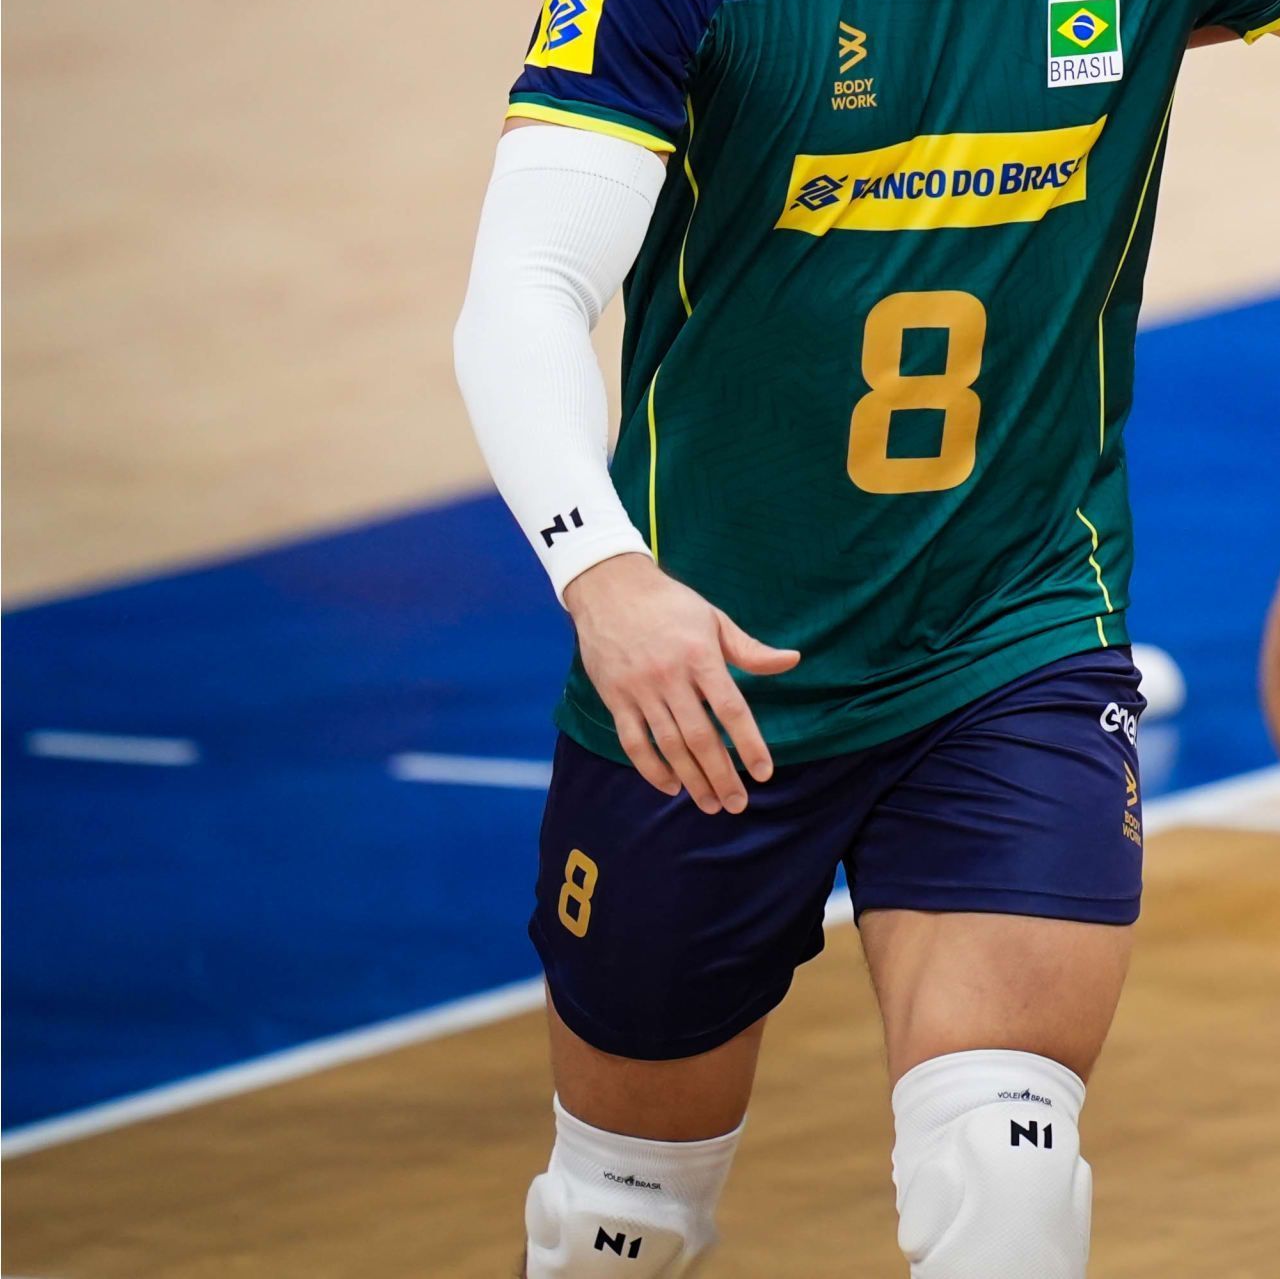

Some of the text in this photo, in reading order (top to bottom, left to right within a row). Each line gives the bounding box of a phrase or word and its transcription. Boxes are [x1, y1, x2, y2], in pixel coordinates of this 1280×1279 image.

[1050, 56, 1120, 82] BRASIL
[834, 78, 874, 95] BODY
[831, 93, 877, 111] WORK
[952, 168, 995, 197] DO
[846, 289, 988, 495] 8
[558, 848, 598, 937] 8
[1010, 1119, 1053, 1149] N1
[594, 1226, 642, 1259] N1
